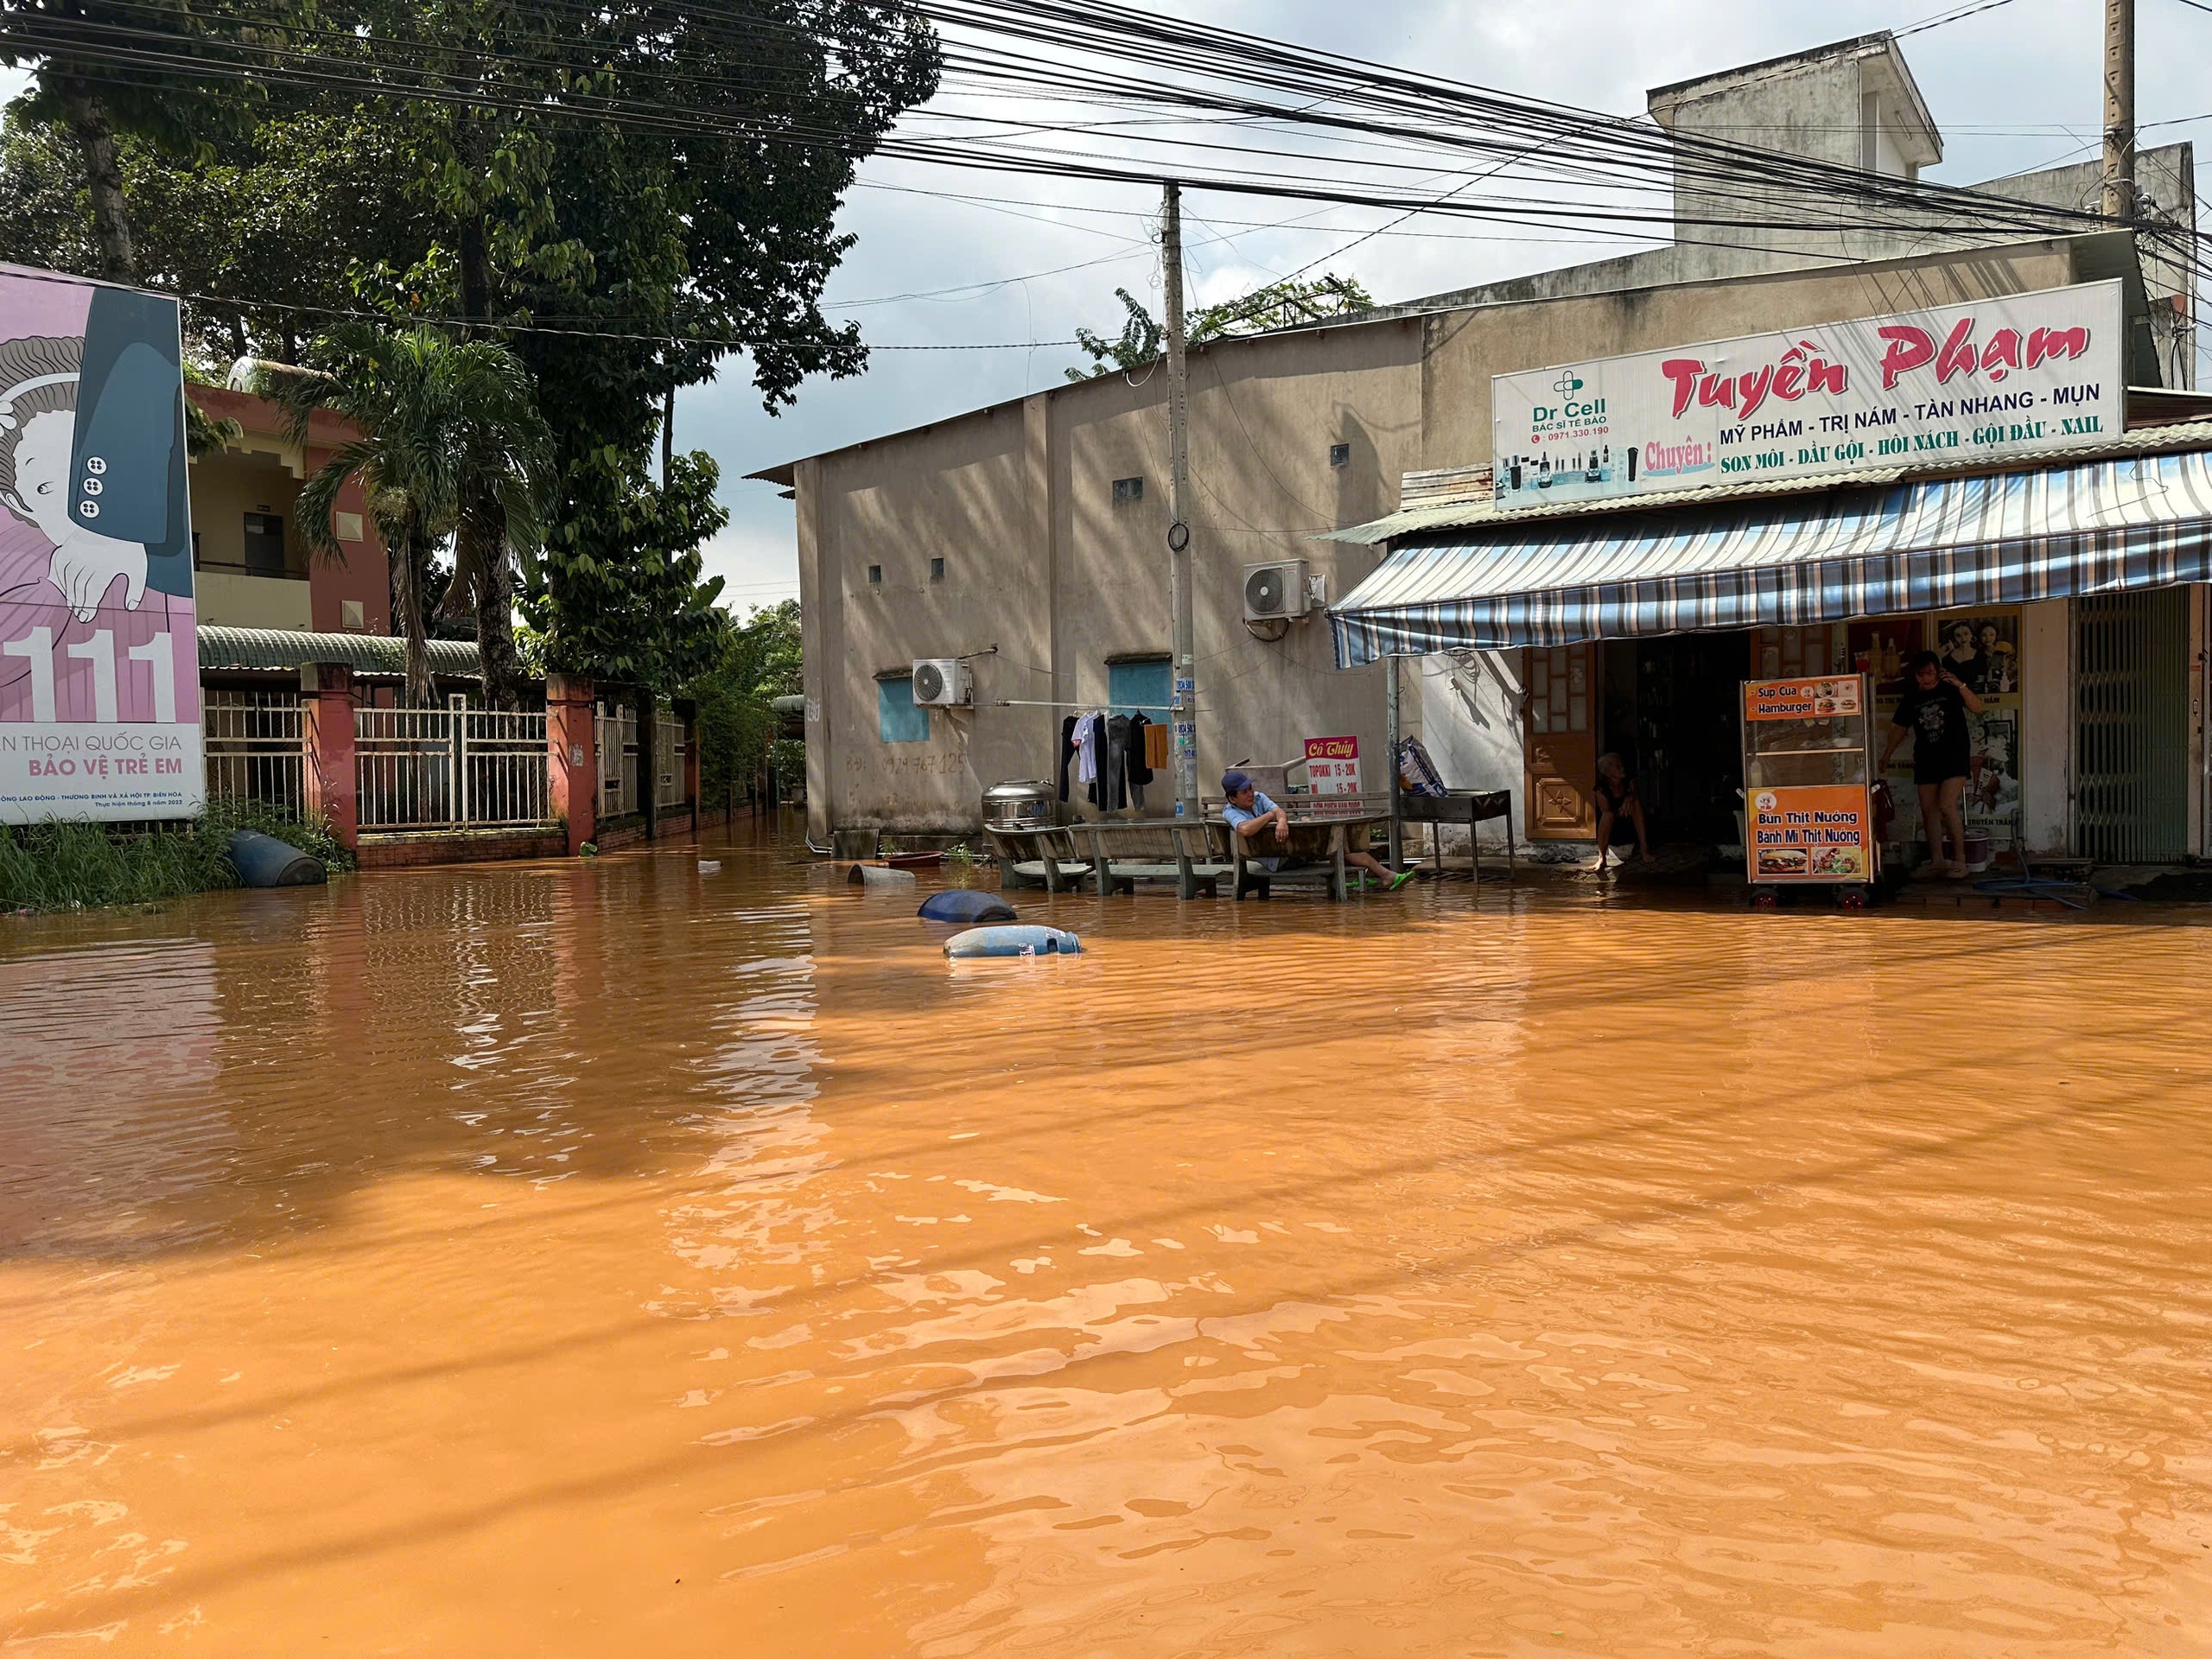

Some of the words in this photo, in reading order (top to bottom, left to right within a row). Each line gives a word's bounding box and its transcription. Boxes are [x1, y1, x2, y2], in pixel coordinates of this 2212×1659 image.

[1661, 340, 1849, 420] Tuyền
[1877, 317, 2091, 391] Phạm
[1533, 406, 1558, 422] Dr
[1564, 398, 1605, 417] Cell
[1720, 421, 1745, 445] MỸ
[1751, 418, 1802, 442] PHẨM
[1819, 414, 1848, 434] TRỊ
[1855, 406, 1897, 429] NÁM
[1914, 399, 1954, 421] TÀN
[1961, 391, 2033, 415] NHANG
[2053, 383, 2100, 407] MỤN
[1532, 422, 1554, 432] BÁC
[1584, 416, 1607, 426] BÀO
[1548, 426, 1609, 442] 0971.330.190
[1720, 454, 1751, 474] SON
[1755, 448, 1785, 468] MÔI
[1798, 441, 1830, 464] DẦU
[1834, 440, 1864, 465] GỘI
[1878, 434, 1908, 455] HÔI
[1913, 430, 1959, 451] NÁCH
[1973, 423, 2005, 449] GỘI
[2010, 416, 2047, 442] ĐẦU
[2061, 415, 2103, 435] NAIL
[1645, 435, 1704, 474] Chuyên
[3, 626, 176, 722] 111
[1758, 687, 1776, 699] Súp
[1779, 686, 1797, 696] Cua
[1758, 702, 1812, 714] Hamburger
[0, 736, 16, 751] N
[22, 736, 79, 754] THOẠI
[86, 731, 143, 750] QUỐC
[149, 735, 181, 750] GIA
[1308, 742, 1323, 757] Cô
[29, 753, 76, 776] BẢO
[83, 754, 108, 779] VỆ
[114, 753, 148, 774] TRẺ
[155, 758, 182, 773] EM
[1309, 765, 1331, 778] TOPOKKI
[1334, 764, 1341, 777] 15
[1345, 763, 1356, 776] 20K
[1337, 783, 1343, 793] 15
[1758, 813, 1782, 824] Bún
[1786, 812, 1810, 826] Thịt
[1758, 830, 1782, 843] Bánh
[1802, 829, 1821, 846] Thịt
